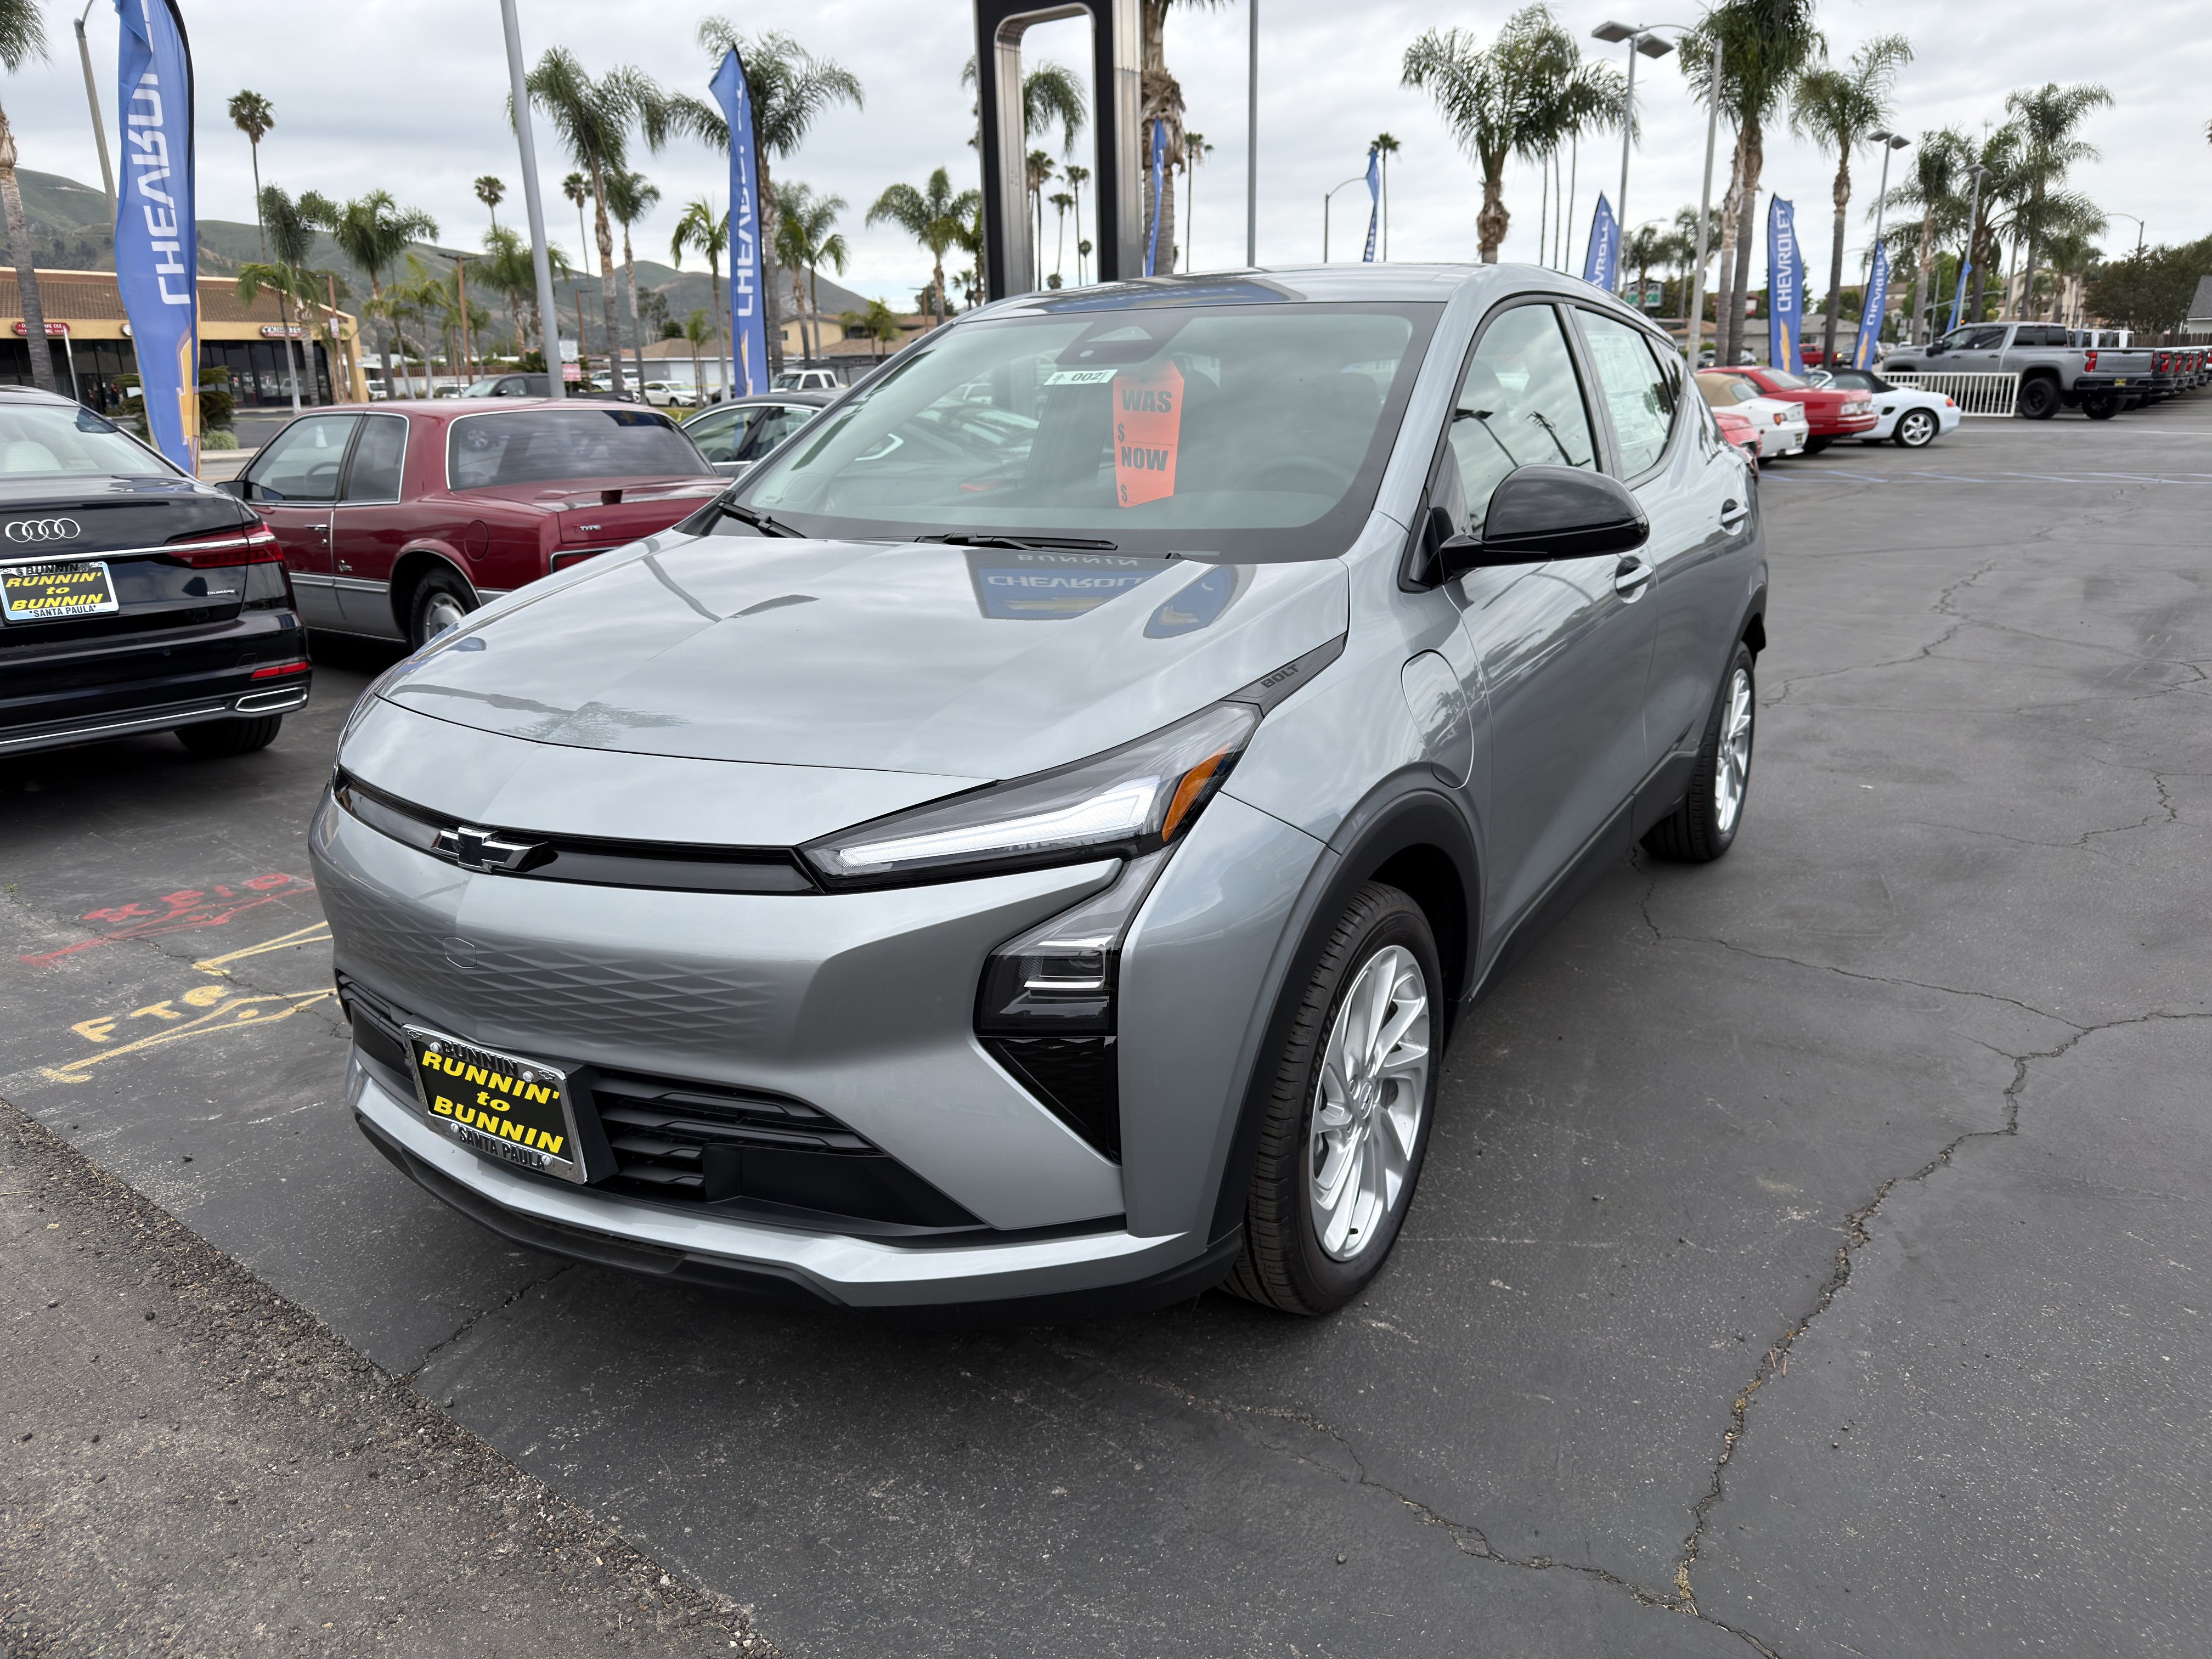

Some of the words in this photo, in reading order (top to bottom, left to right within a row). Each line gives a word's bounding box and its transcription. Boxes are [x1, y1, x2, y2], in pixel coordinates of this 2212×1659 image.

[1775, 206, 1792, 312] CHEVROLET
[1071, 373, 1103, 381] 002
[1121, 389, 1172, 413] WAS
[1117, 422, 1125, 443] $
[1121, 447, 1169, 472] NOW
[1120, 483, 1128, 504] $
[26, 563, 78, 574] BUNNIN
[5, 572, 103, 588] RUNNIN'
[46, 586, 70, 595] to
[10, 593, 103, 611] BUNNIN
[33, 608, 64, 617] SANTA
[66, 605, 95, 614] PAULA
[1261, 664, 1299, 689] BOLT
[440, 1038, 519, 1077] BUNNIN
[1305, 1003, 1338, 1116] MICHELIN
[422, 1050, 560, 1104] RUNNIN'
[477, 1091, 511, 1112] to
[433, 1095, 564, 1154] BUNNIN
[459, 1126, 499, 1156] SANTA
